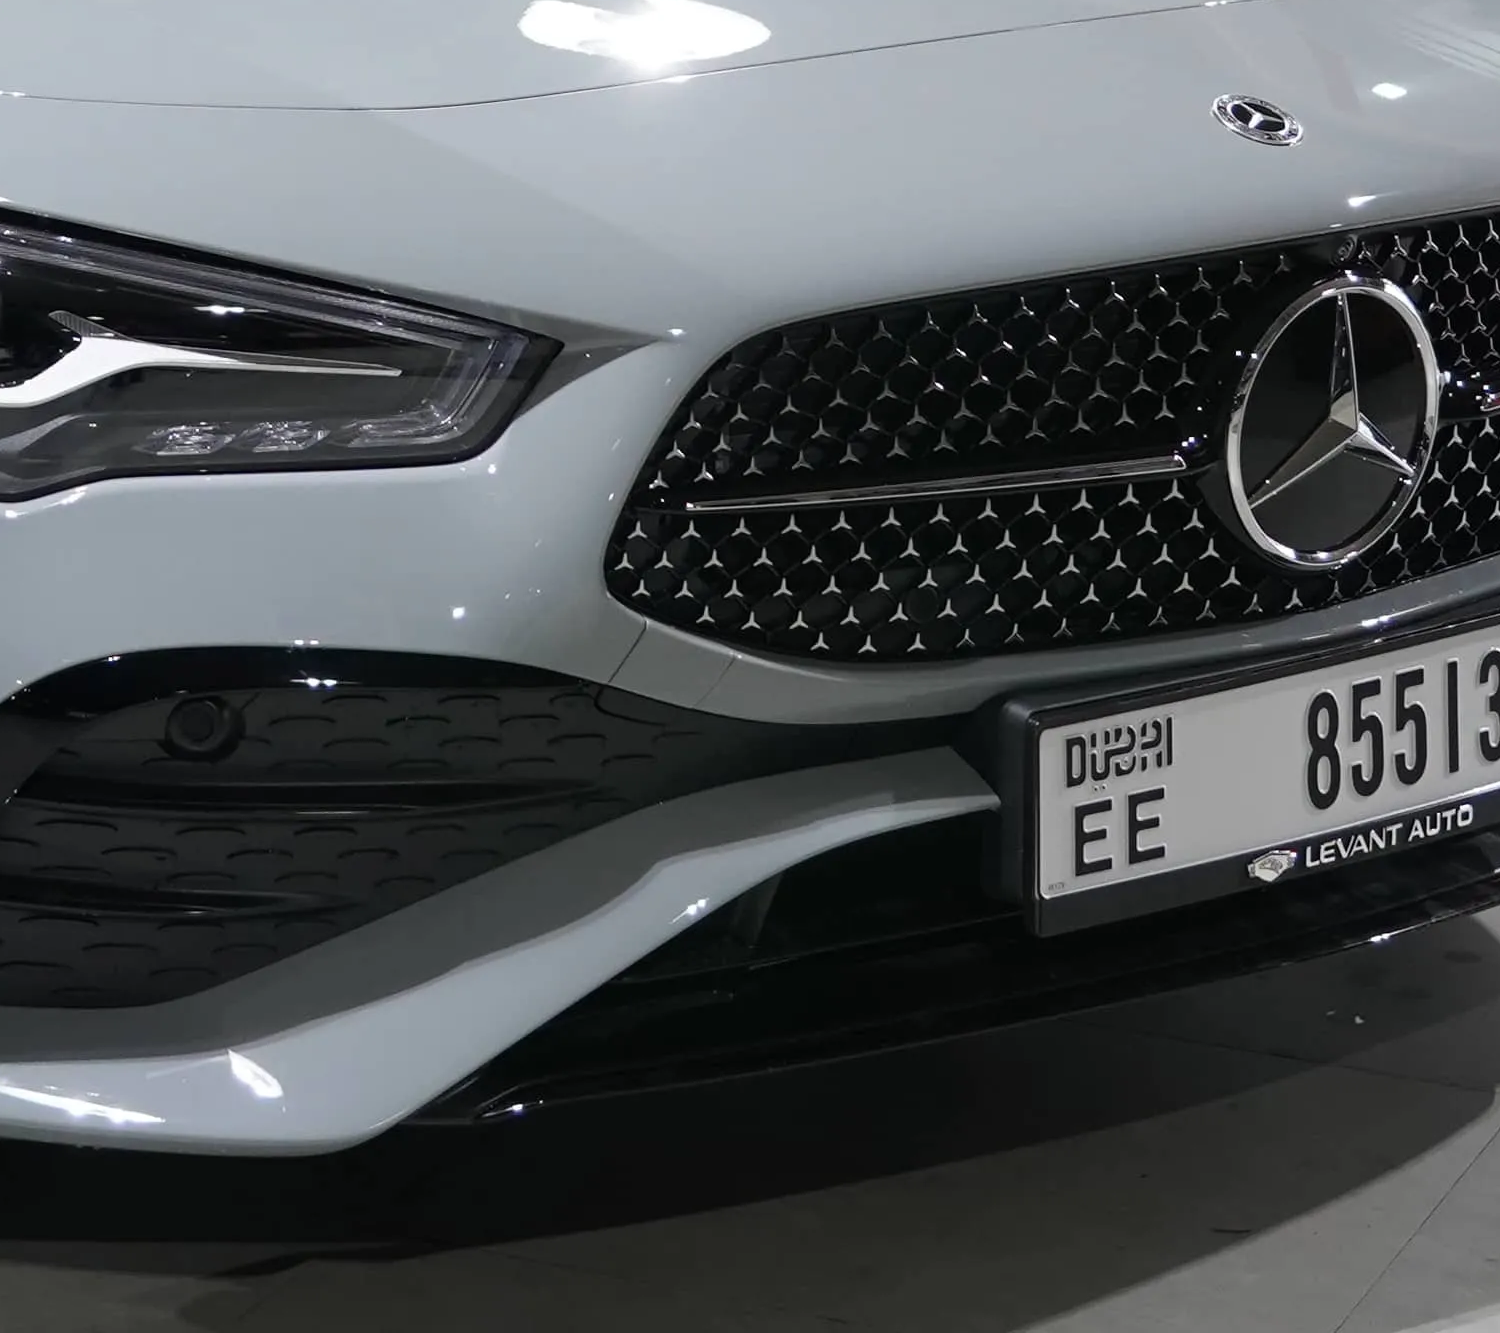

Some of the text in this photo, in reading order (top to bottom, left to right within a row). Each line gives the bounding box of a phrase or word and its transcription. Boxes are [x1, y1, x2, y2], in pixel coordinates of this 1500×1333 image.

[1074, 786, 1165, 878] EE
[1304, 803, 1475, 868] LEVANT AUTO
